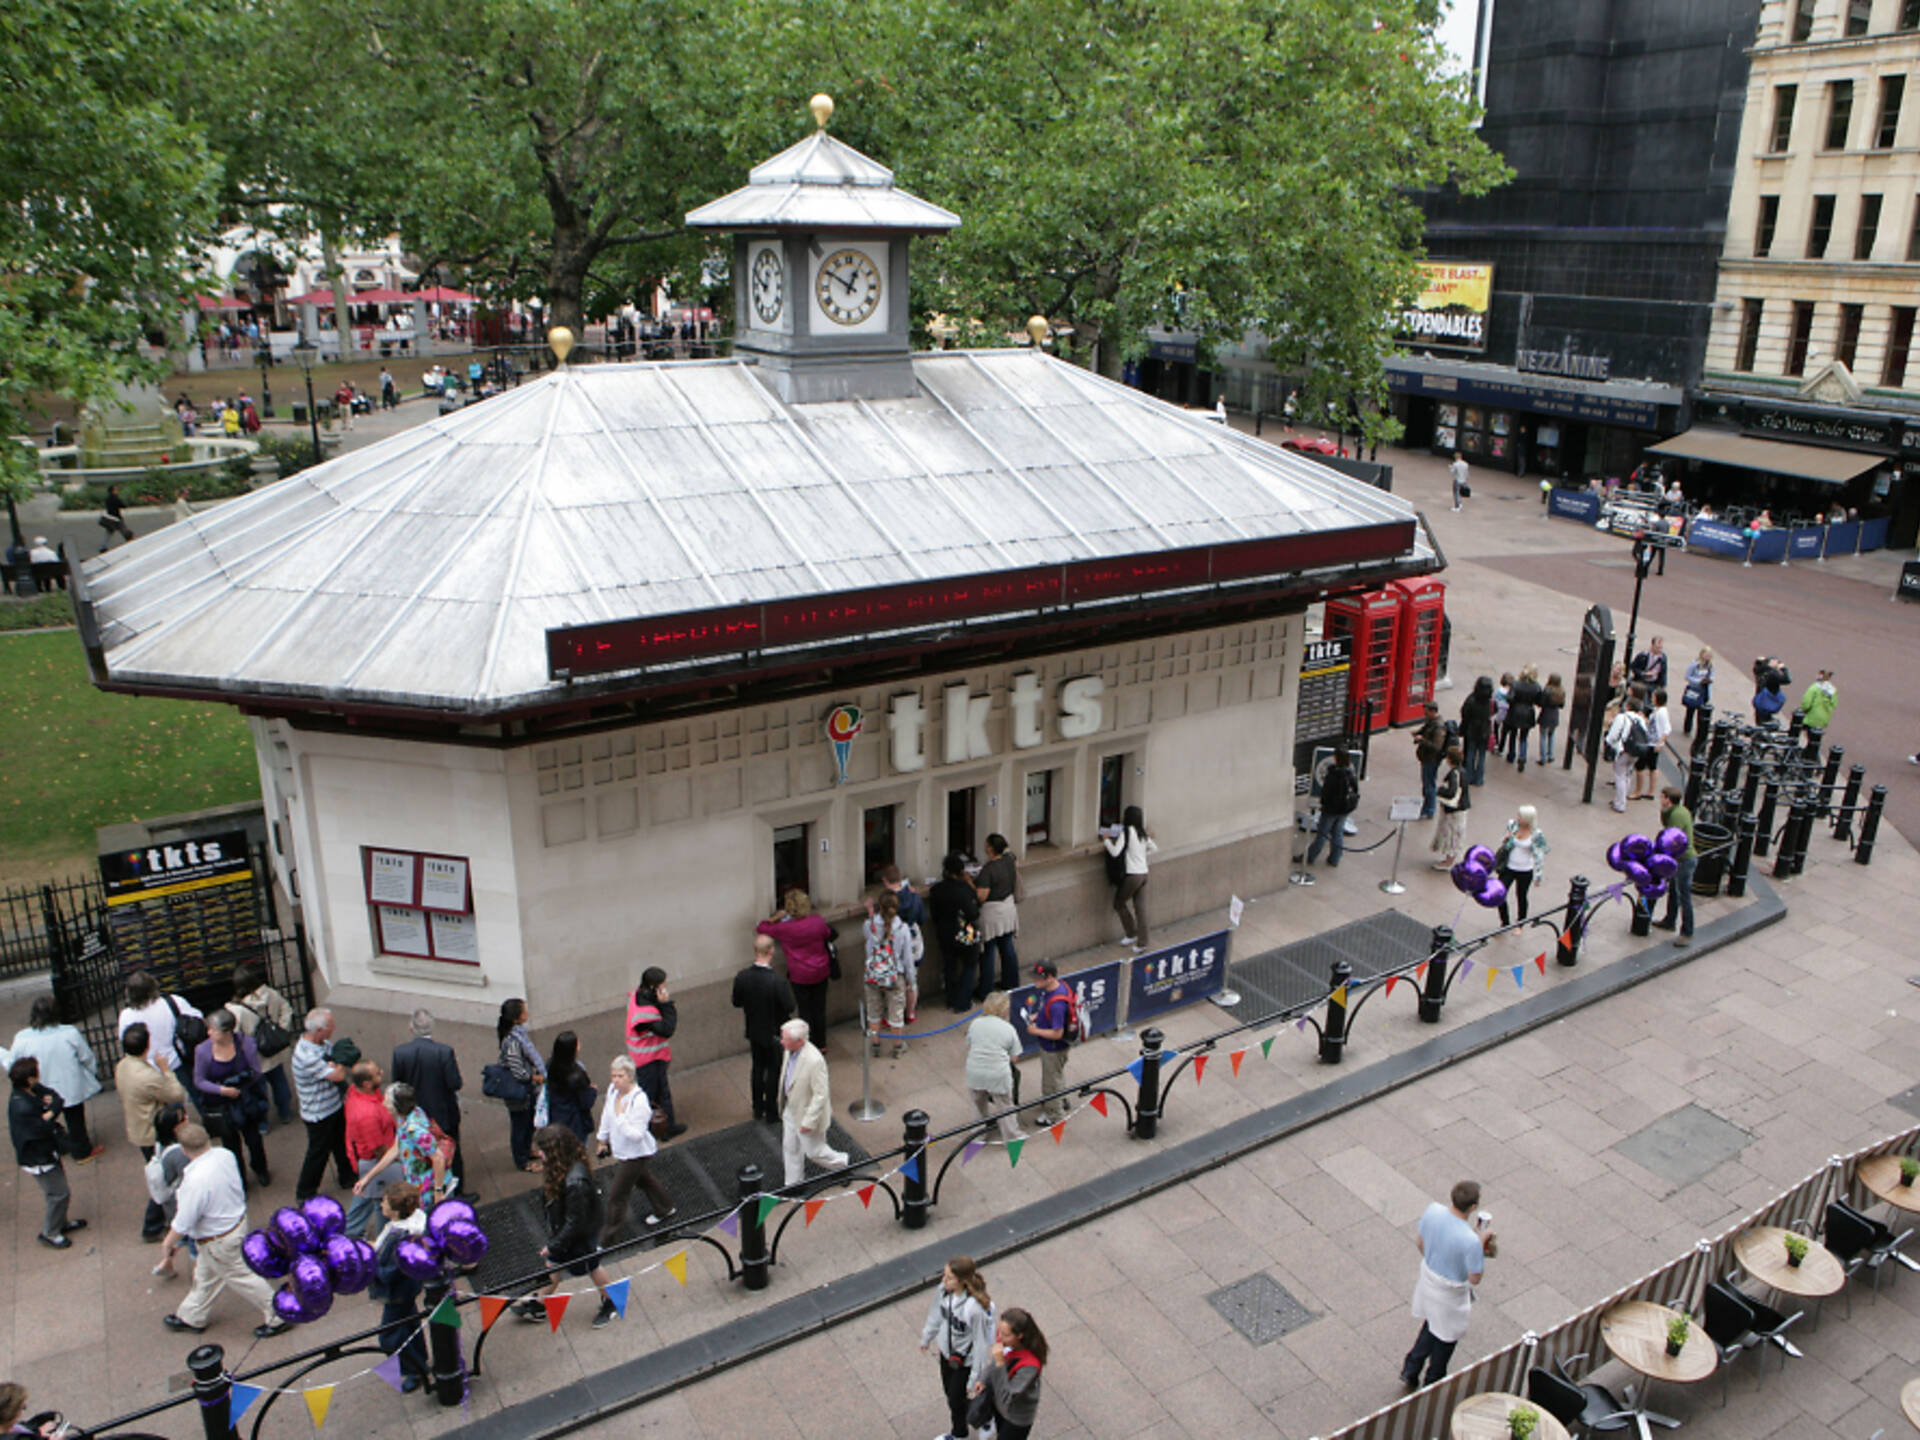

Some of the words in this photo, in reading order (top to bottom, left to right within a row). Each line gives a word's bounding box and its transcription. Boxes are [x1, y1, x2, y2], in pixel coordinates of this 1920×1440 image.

[1309, 641, 1342, 661] tkts
[886, 671, 1104, 773] tkts
[146, 842, 222, 872] tkts
[1156, 946, 1216, 980] tkts
[1075, 978, 1106, 1000] ts
